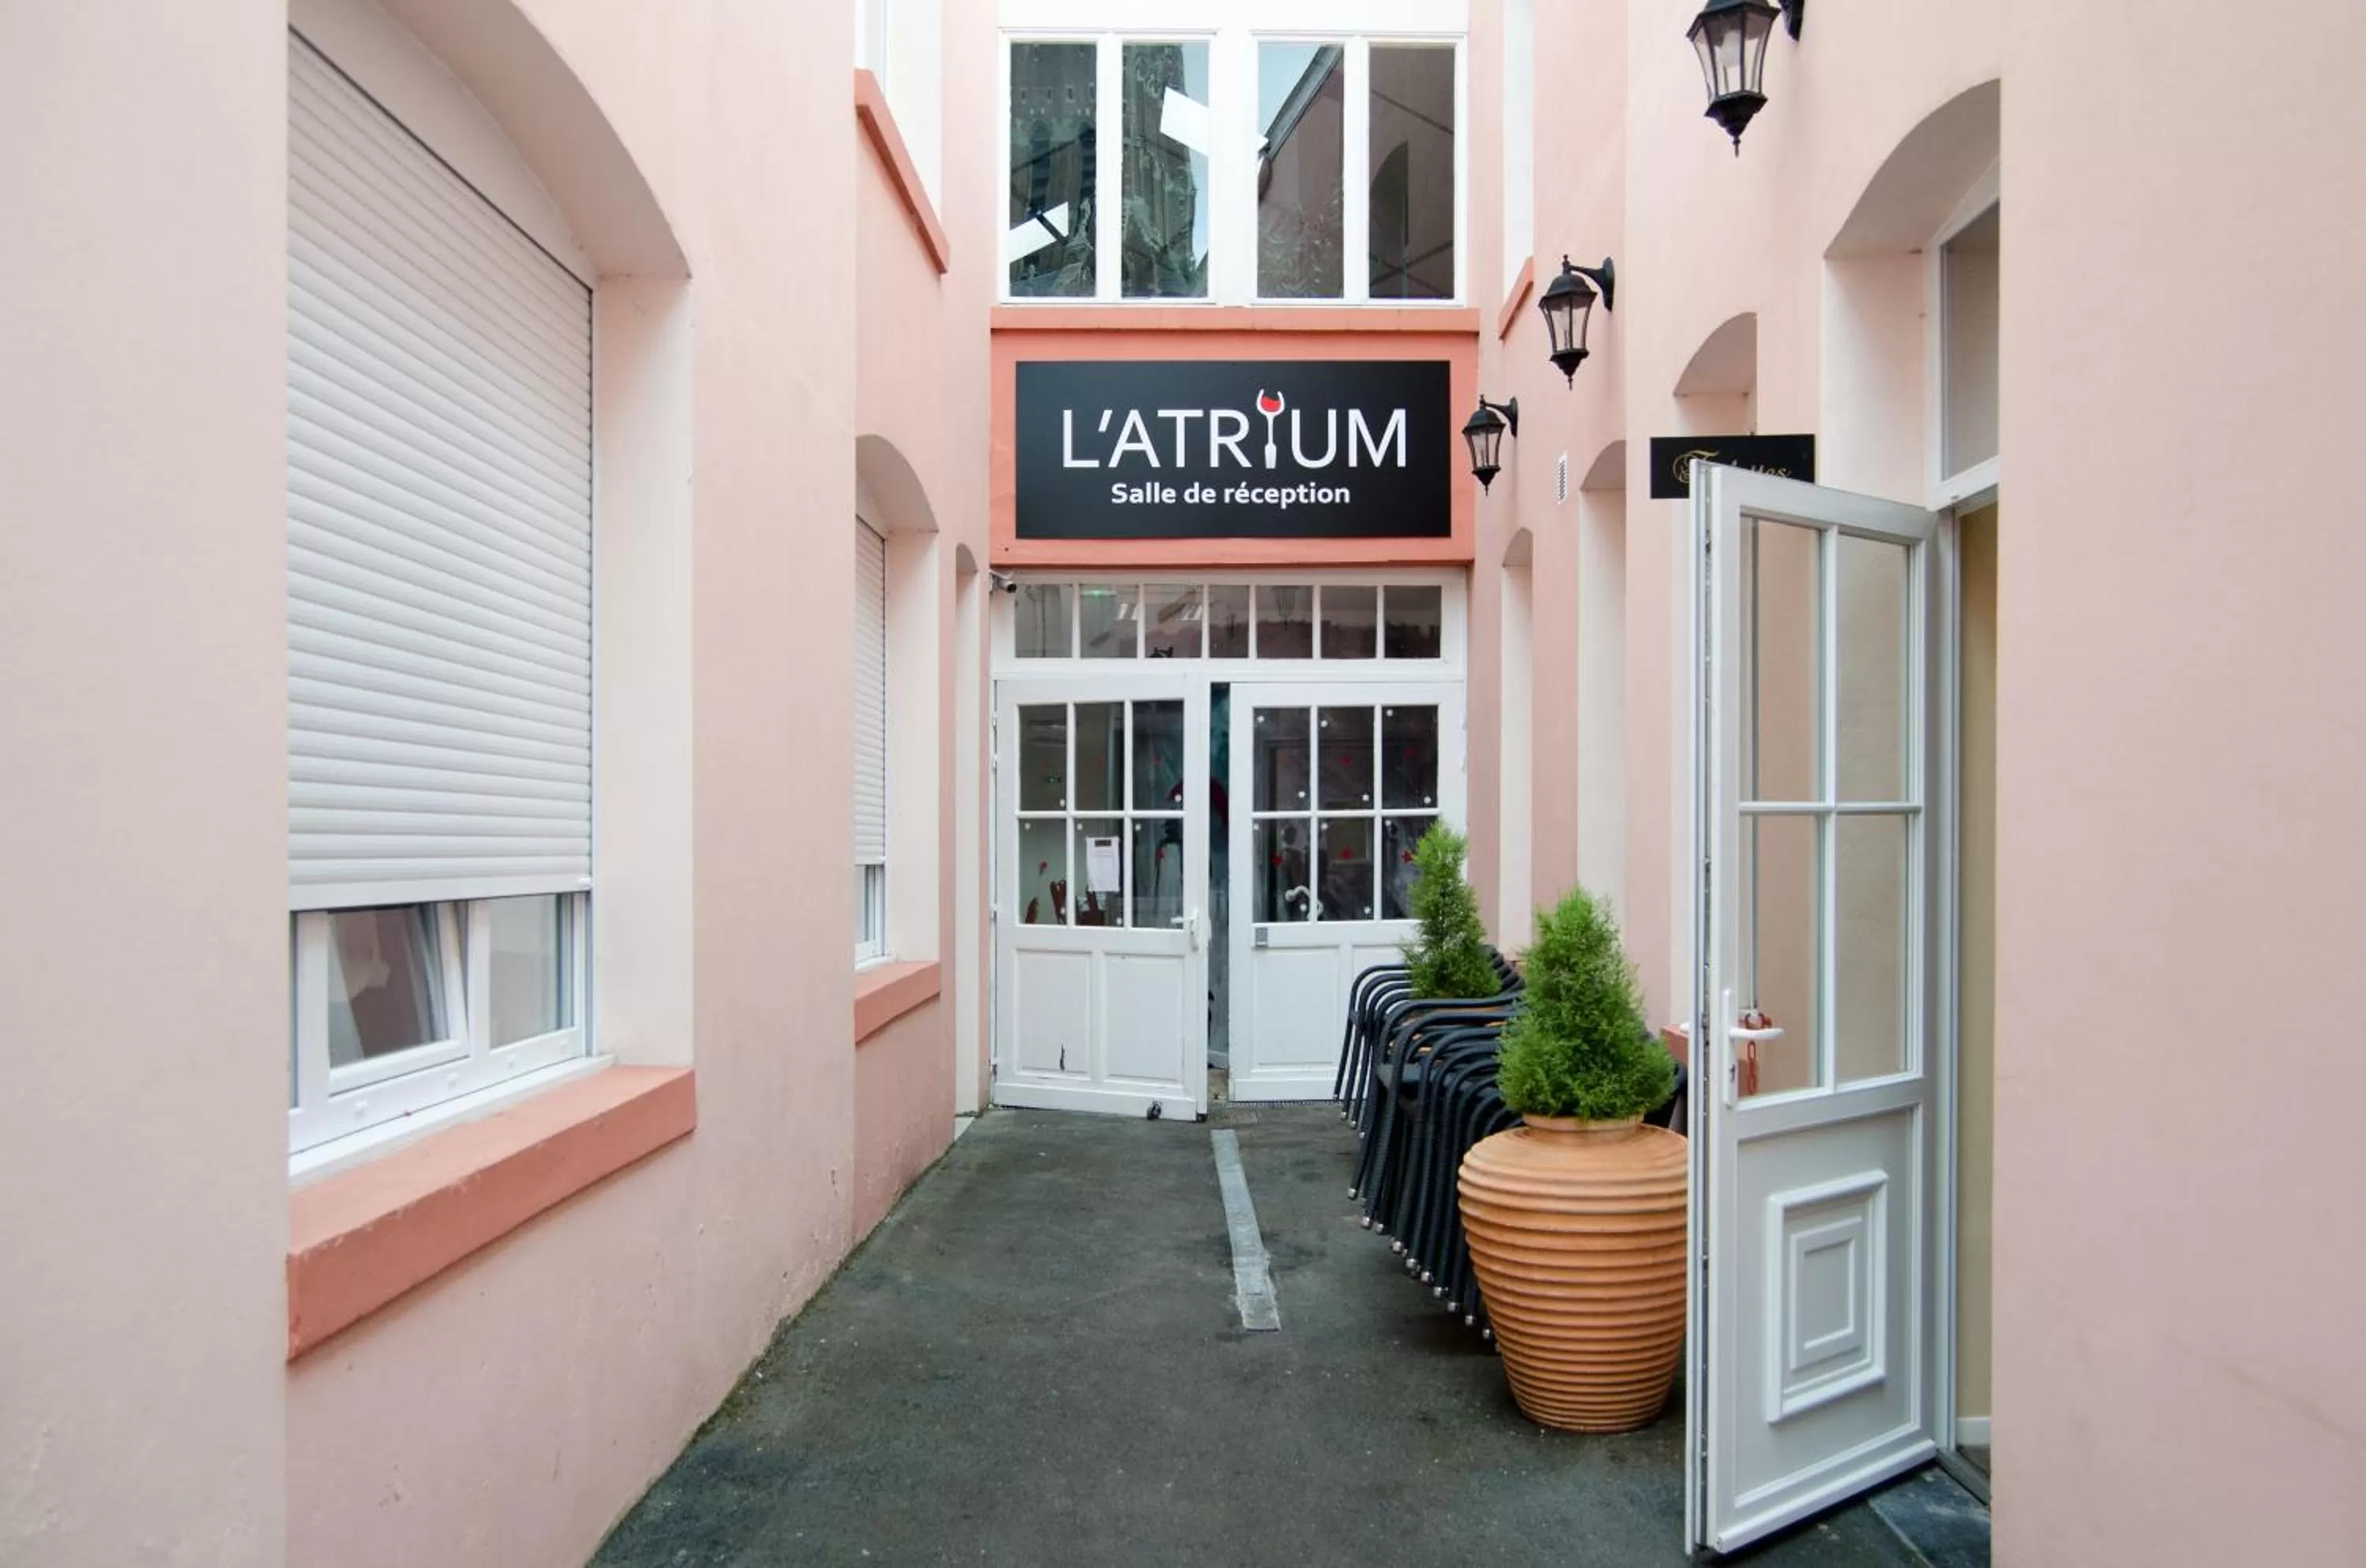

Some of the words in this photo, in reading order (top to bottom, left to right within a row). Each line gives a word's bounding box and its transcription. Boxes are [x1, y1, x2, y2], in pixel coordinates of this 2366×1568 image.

[1063, 389, 1405, 469] L'ATRIUM
[1112, 482, 1176, 503] Salle
[1184, 482, 1216, 503] de
[1224, 482, 1349, 509] réception
